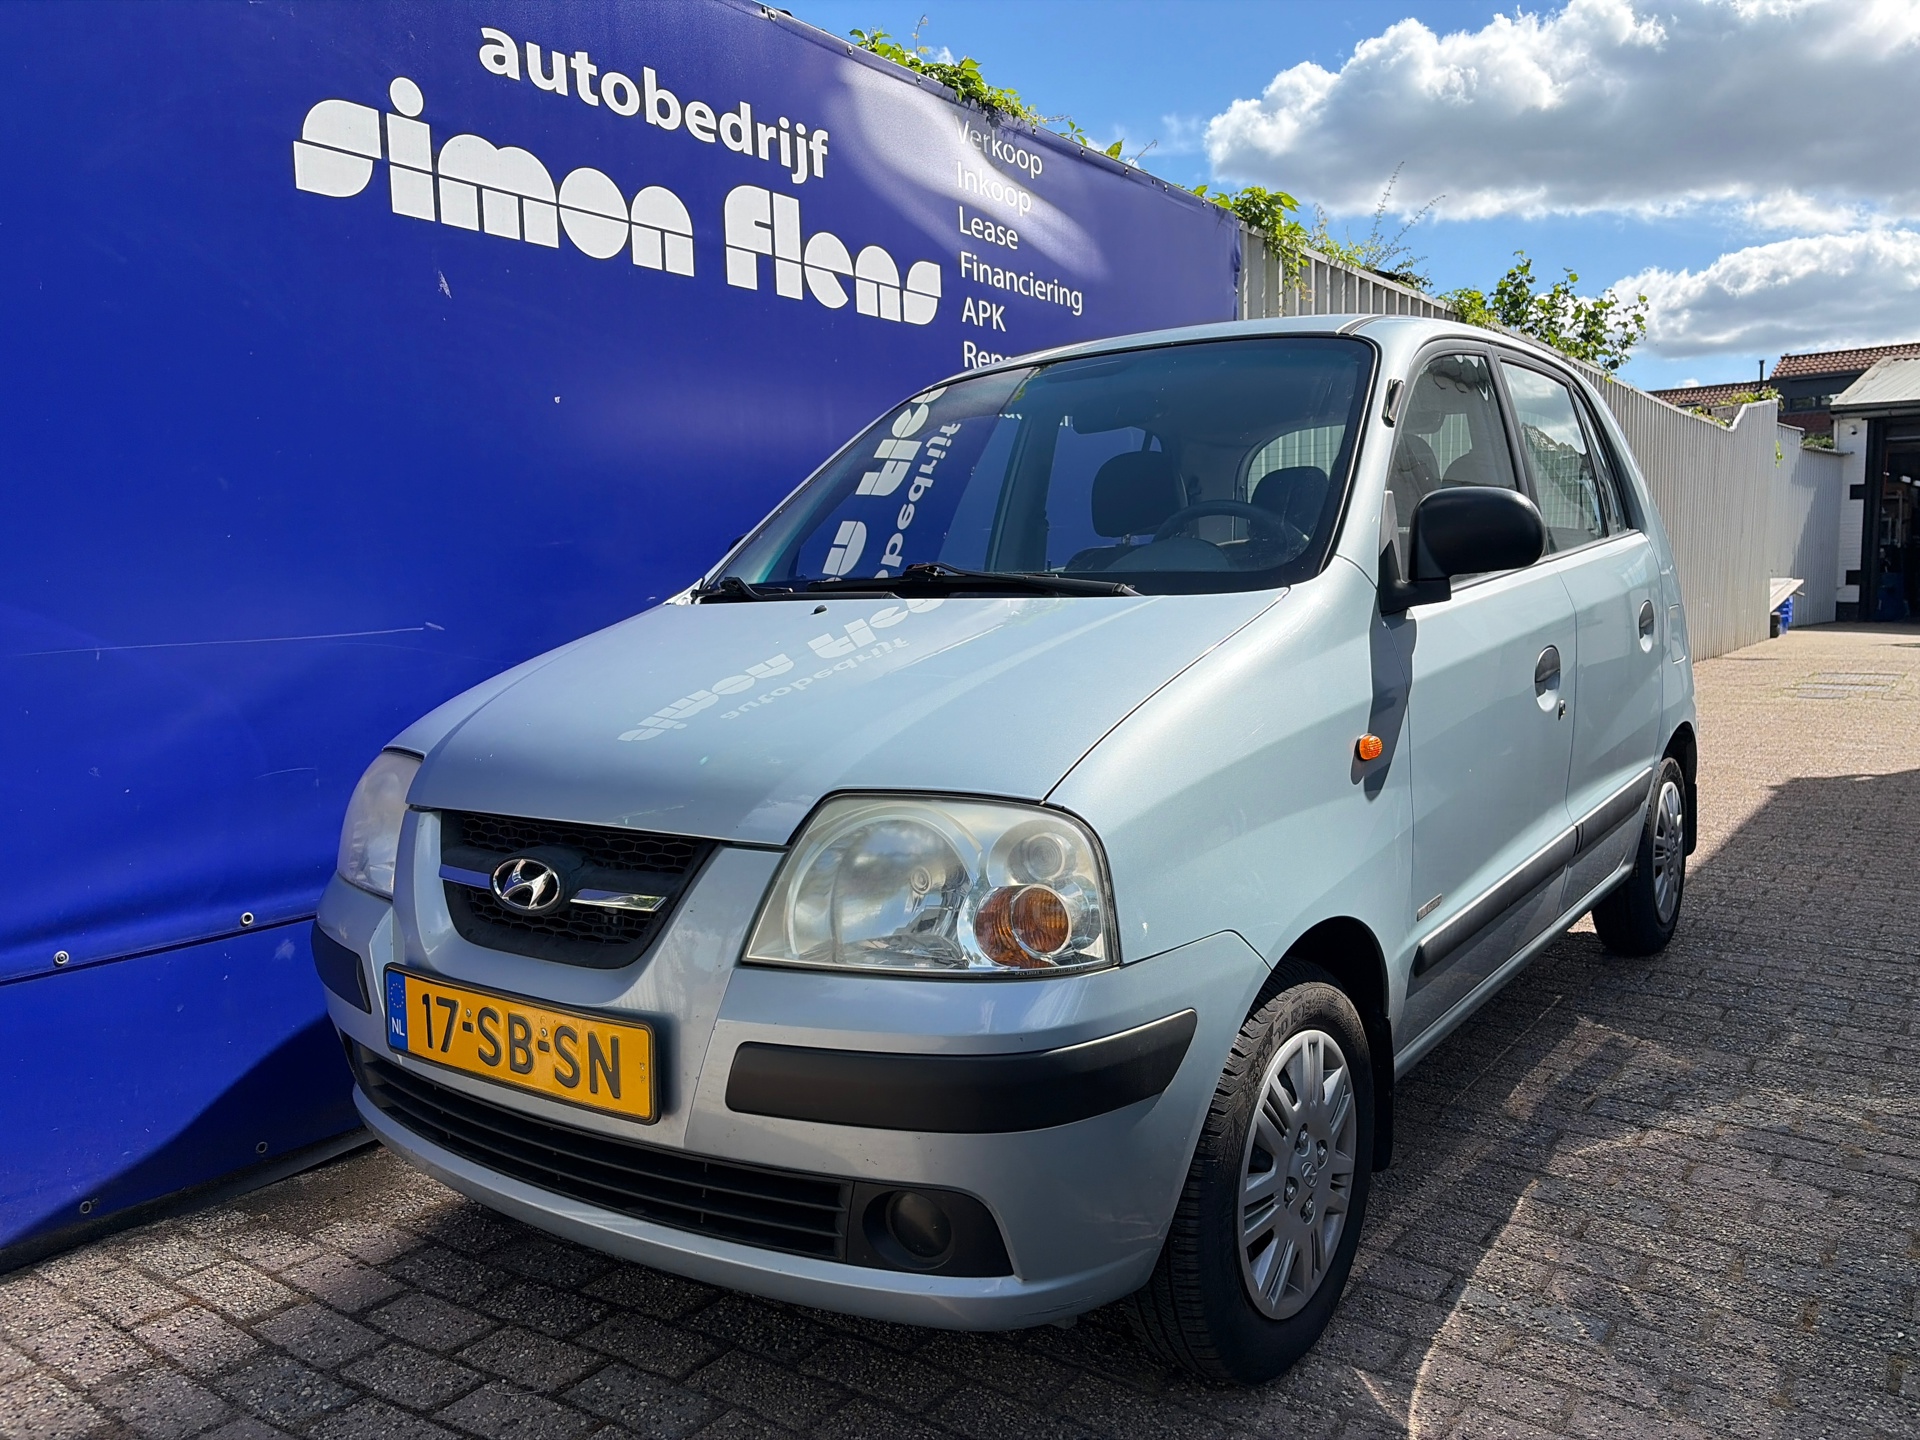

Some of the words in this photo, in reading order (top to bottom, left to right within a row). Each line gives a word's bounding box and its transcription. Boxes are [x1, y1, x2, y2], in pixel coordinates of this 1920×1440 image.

[479, 27, 829, 184] autobedrijf
[955, 115, 1043, 180] Verkoop
[293, 76, 695, 277] simon
[723, 184, 942, 325] flens
[957, 160, 1032, 216] Inkoop
[958, 206, 1018, 250] Lease
[960, 251, 1083, 316] Financiering
[961, 297, 1006, 332] APK
[963, 341, 1011, 369] Re
[391, 1016, 405, 1037] NL
[421, 993, 621, 1099] 17-SB-SN
